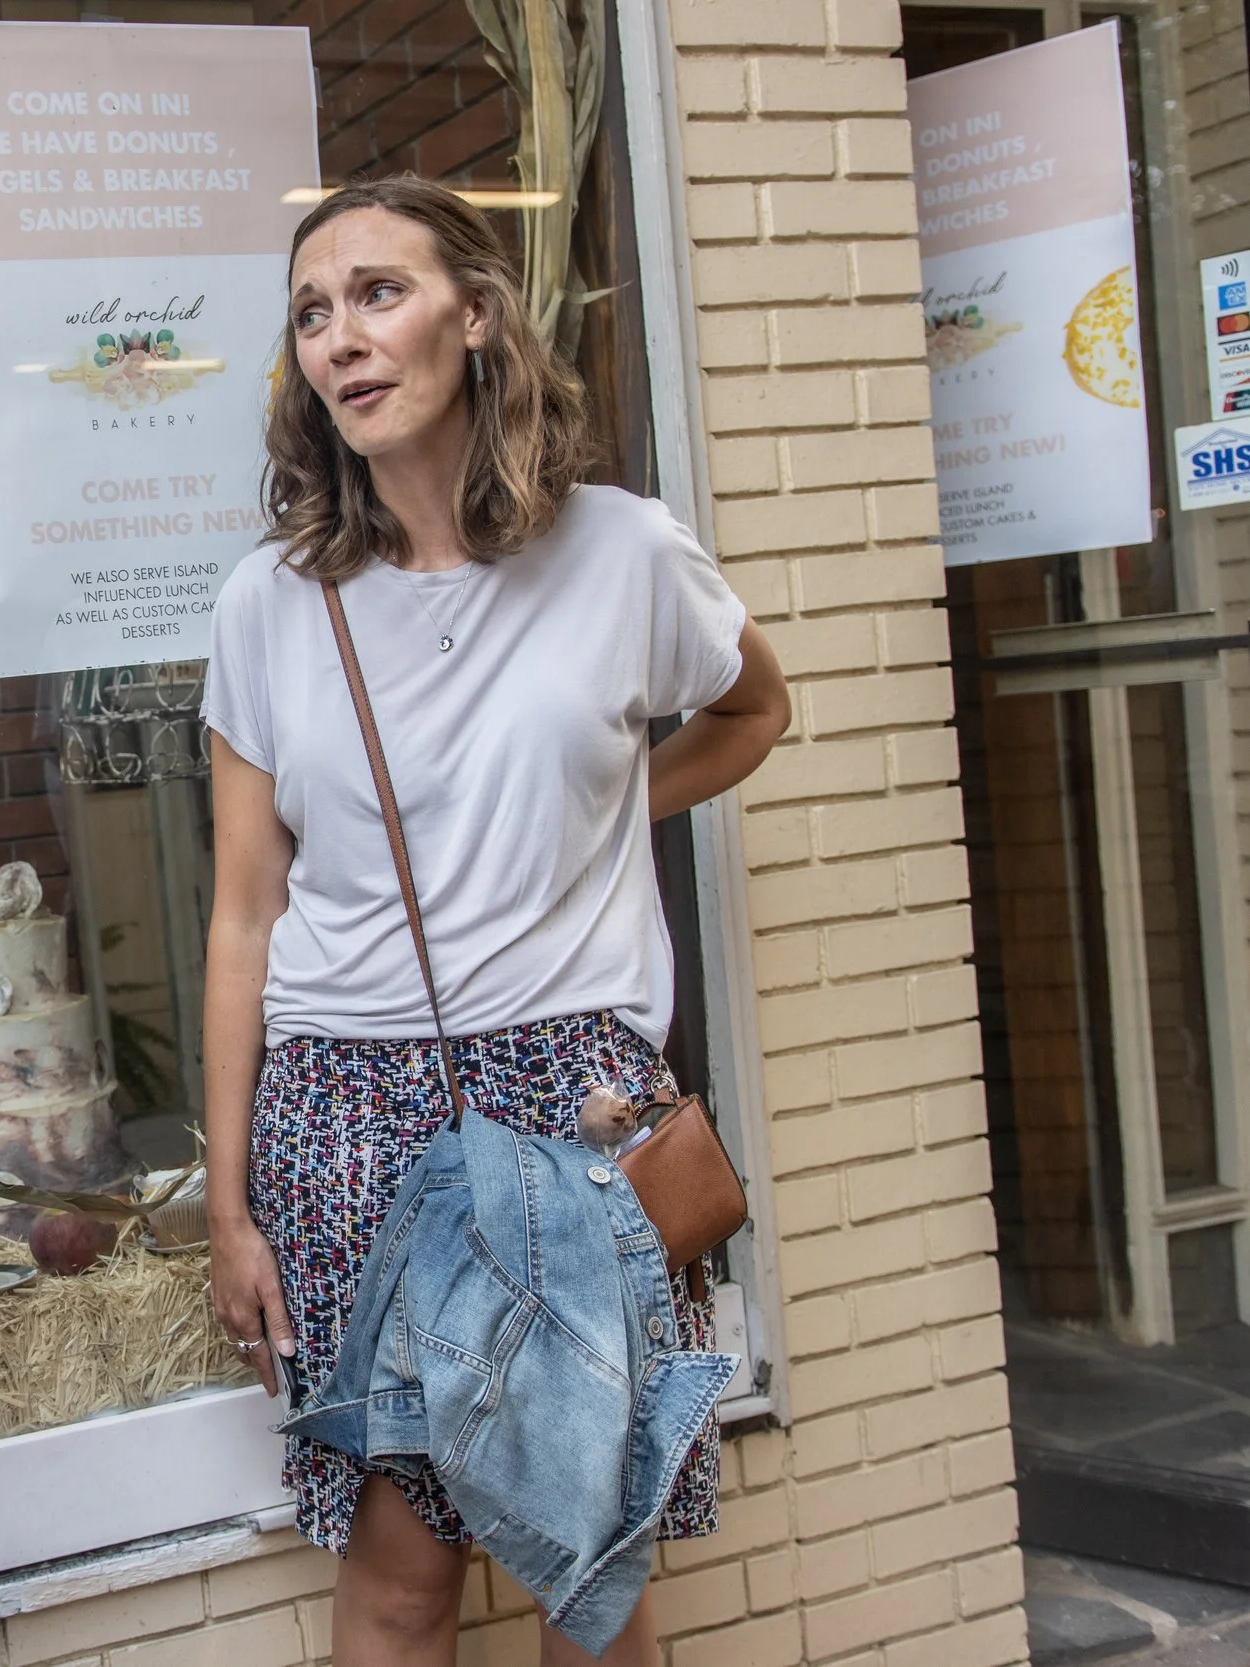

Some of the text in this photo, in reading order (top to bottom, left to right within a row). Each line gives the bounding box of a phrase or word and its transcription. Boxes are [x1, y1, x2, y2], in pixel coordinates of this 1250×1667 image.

[7, 90, 191, 116] COME ON IN!
[21, 130, 98, 155] HAVE
[919, 122, 958, 148] ON
[72, 169, 94, 193] &
[104, 167, 252, 192] BREAKFAST
[922, 157, 1057, 208] BREAKFAST
[19, 205, 203, 232] SANDWICHES
[919, 200, 1009, 237] WICHES
[65, 294, 205, 325] wild orchid
[1223, 343, 1250, 355] VISA
[91, 413, 196, 431] BAKERY
[971, 412, 1013, 434] TRY
[1192, 444, 1250, 478] SHS
[81, 473, 217, 504] COME TRY
[973, 482, 1014, 498] ISLAND
[965, 500, 1006, 513] LUNCH
[988, 511, 1025, 526] CAKES
[1027, 509, 1037, 520] &
[30, 511, 193, 545] SOMETHING
[71, 562, 219, 585] WE ALSO SERVE ISLAND
[83, 582, 209, 604] INFLUENCED LUNCH
[55, 600, 216, 626] AS WELL AS CUSTOM CAK
[121, 622, 181, 639] DESSERTS
